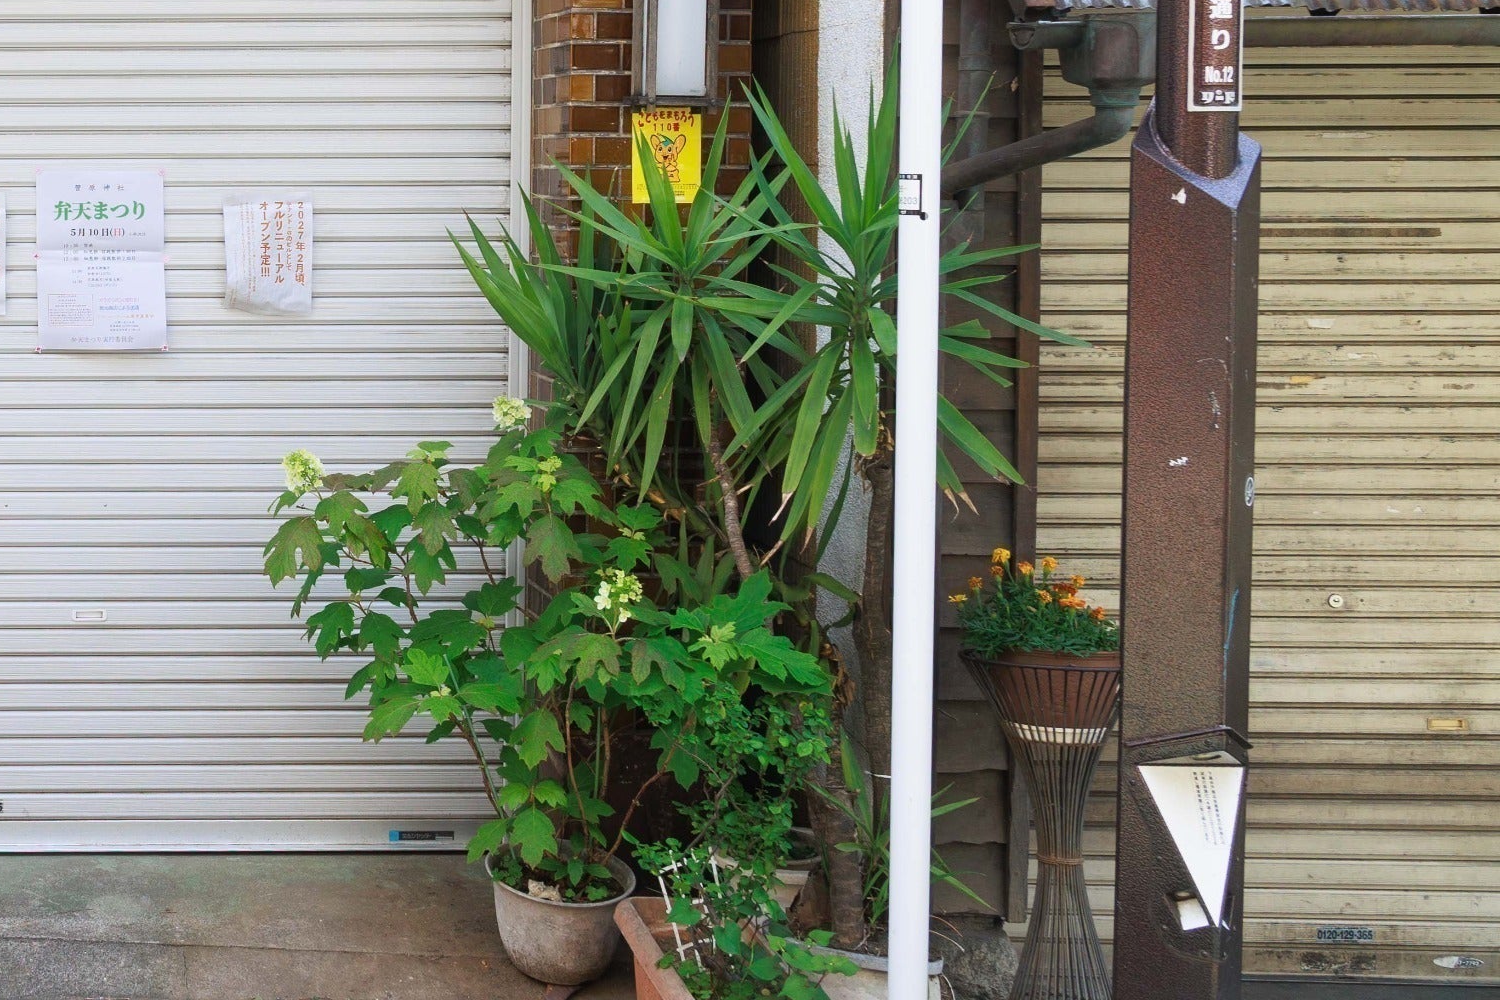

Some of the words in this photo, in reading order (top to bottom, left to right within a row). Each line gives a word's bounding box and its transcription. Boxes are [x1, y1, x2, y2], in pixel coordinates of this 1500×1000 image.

[1204, 66, 1234, 83] No.12
[53, 200, 145, 220] 弁天まつり
[274, 201, 285, 283] フルリニューアル
[1317, 929, 1373, 940] 0120-129-365
